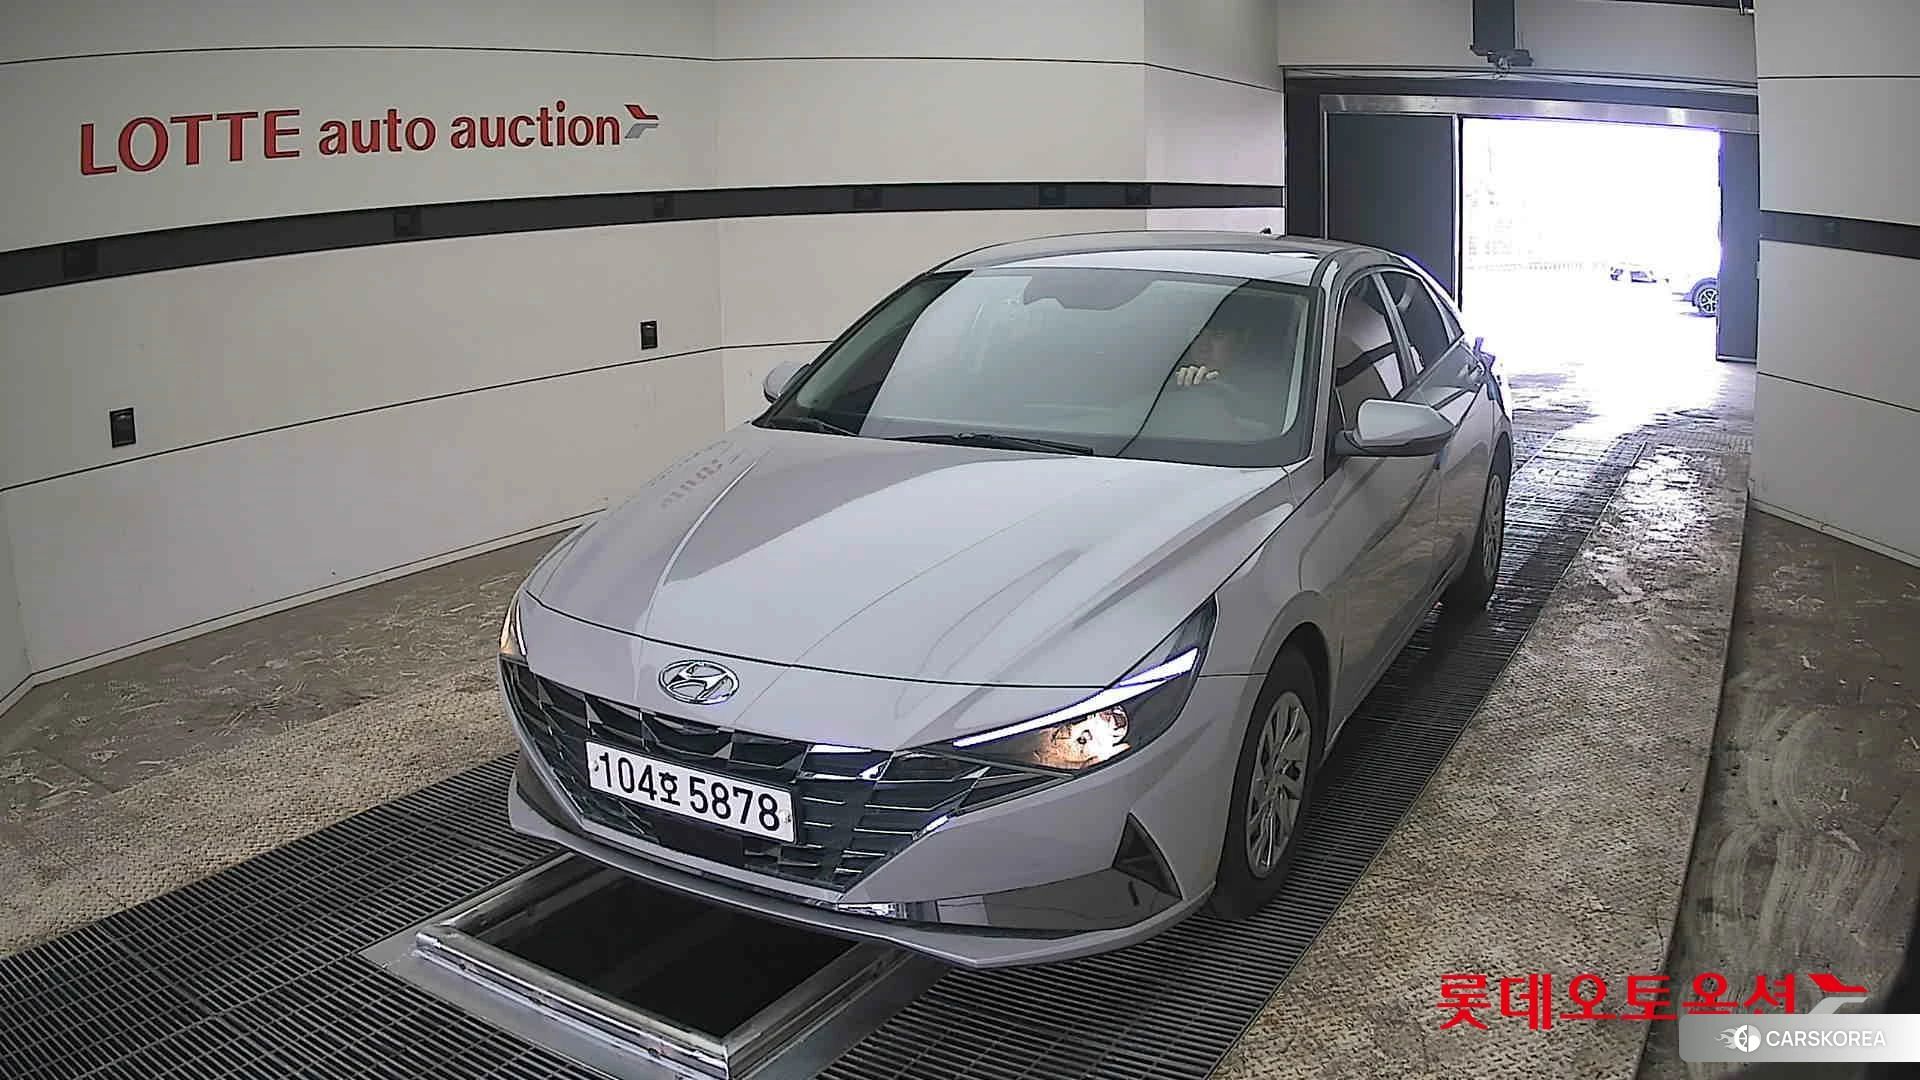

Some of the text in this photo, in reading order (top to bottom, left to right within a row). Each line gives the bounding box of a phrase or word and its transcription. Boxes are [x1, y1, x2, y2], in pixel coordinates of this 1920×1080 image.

[80, 100, 621, 176] LOTTE auto auction
[689, 776, 780, 831] 5878
